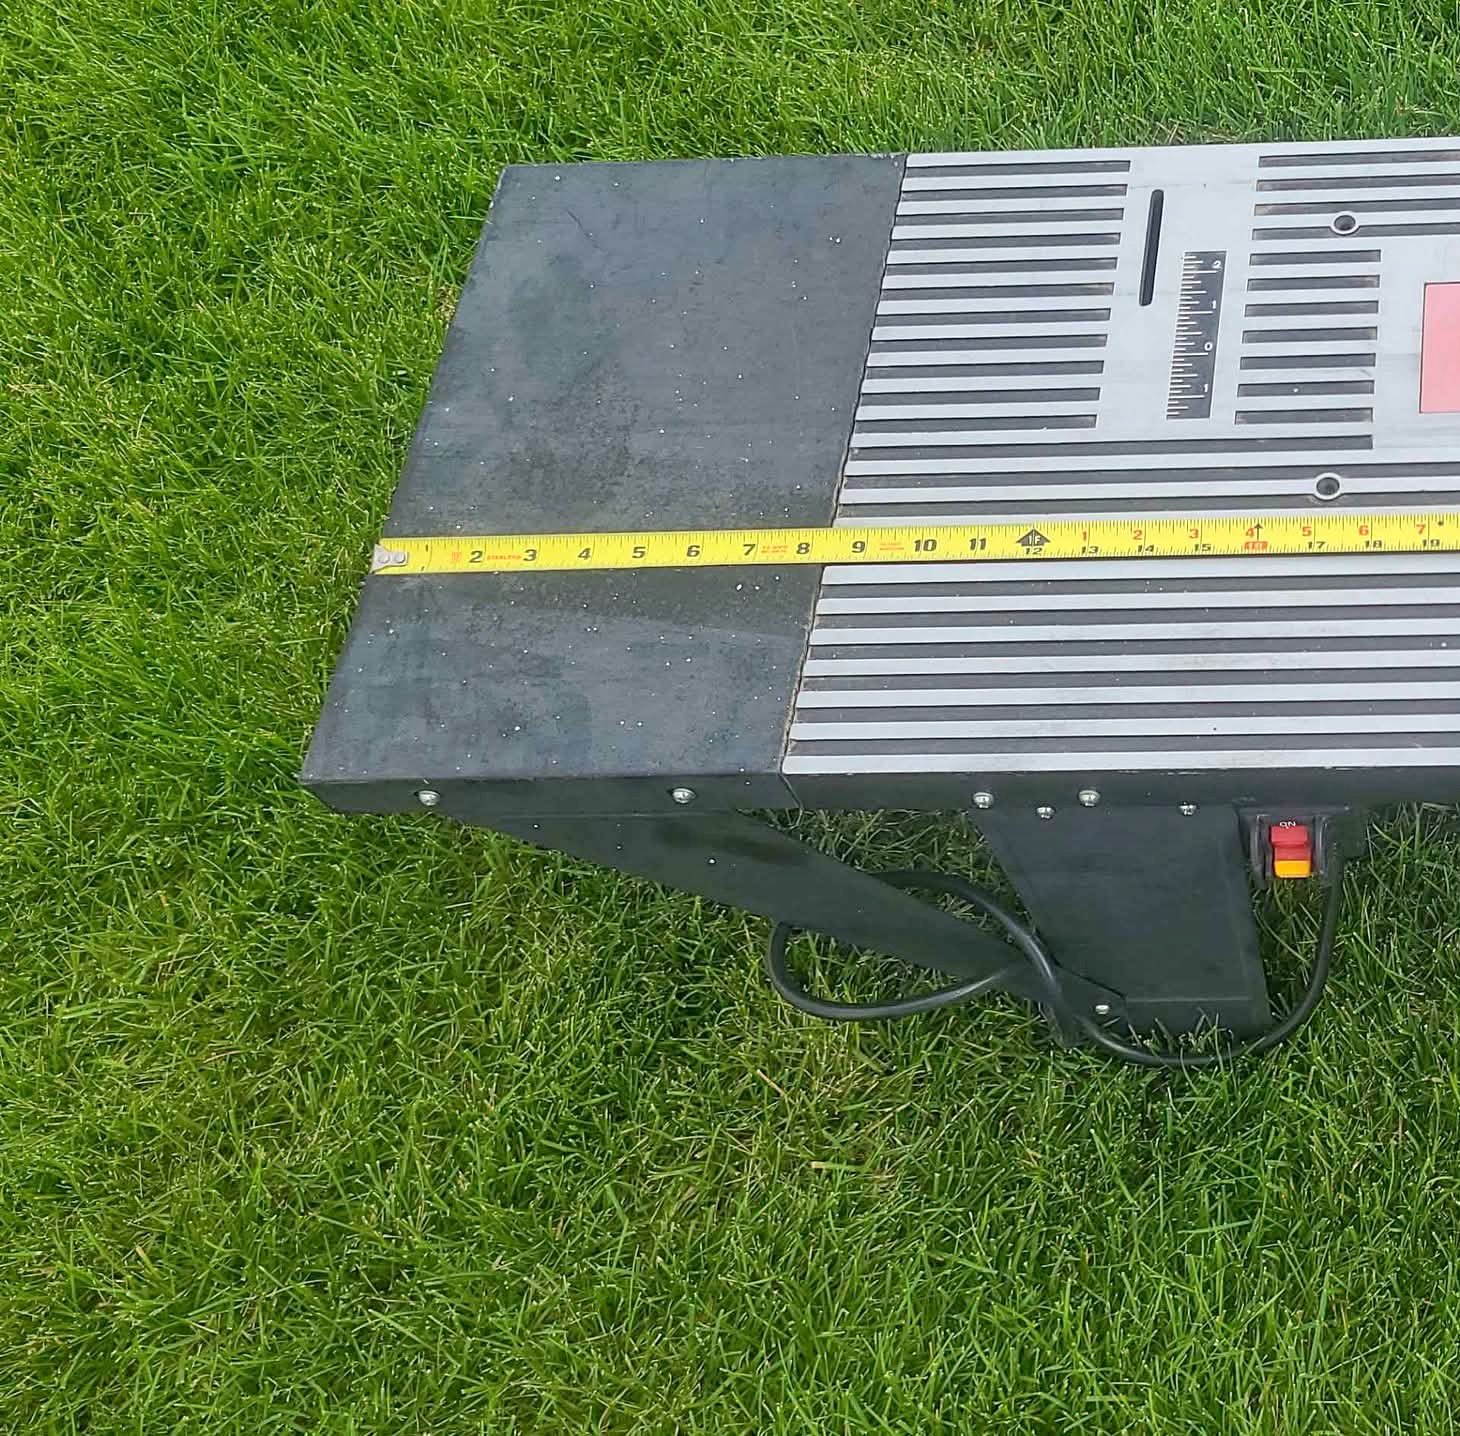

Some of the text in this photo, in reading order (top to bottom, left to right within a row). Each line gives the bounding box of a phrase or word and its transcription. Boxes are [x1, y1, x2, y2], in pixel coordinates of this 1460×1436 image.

[1212, 260, 1222, 269] 2
[1212, 300, 1217, 309] 1
[1204, 342, 1213, 350] 0
[1203, 384, 1209, 392] 1
[1082, 532, 1088, 542] 1
[1133, 530, 1144, 540] 2
[1188, 528, 1199, 539] 3
[1245, 527, 1255, 538] 4
[1302, 526, 1313, 537] 5
[1358, 525, 1369, 536] 6
[1415, 524, 1426, 535] 7
[469, 550, 484, 563] 2
[523, 549, 537, 562] 3
[577, 548, 592, 560] 4
[632, 546, 646, 558] 5
[686, 544, 700, 558] 6
[742, 544, 756, 556] 7
[796, 542, 810, 555] 8
[852, 540, 866, 554] 9
[914, 538, 938, 552] 10
[969, 538, 987, 551] 11
[1024, 547, 1042, 555] 12
[1080, 546, 1099, 554] 13
[1136, 544, 1154, 553] 14
[1193, 544, 1212, 552] 15
[1307, 540, 1326, 550] 17
[1364, 540, 1382, 548] 18
[1422, 538, 1440, 548] 19
